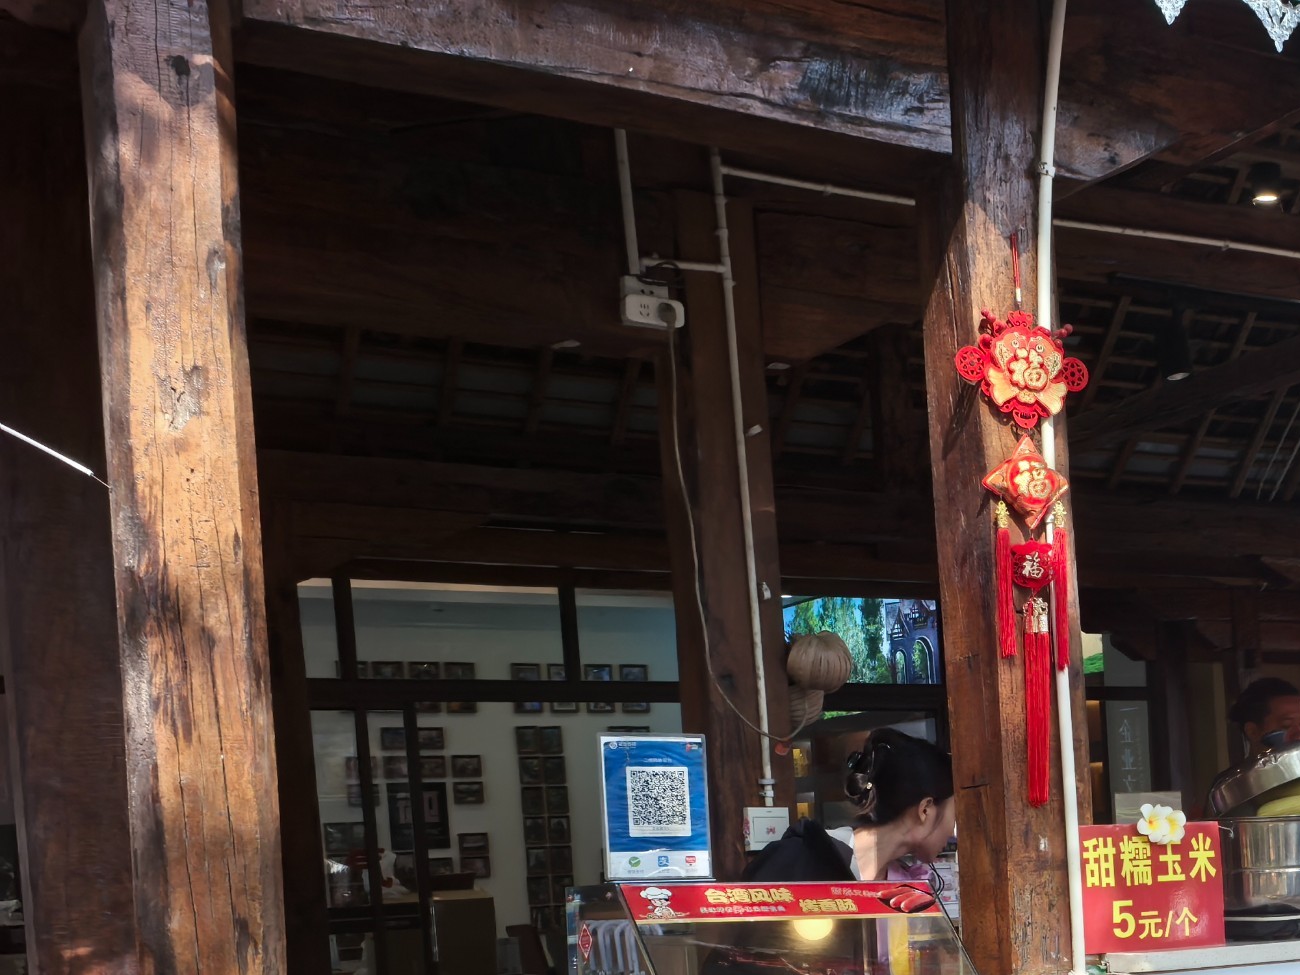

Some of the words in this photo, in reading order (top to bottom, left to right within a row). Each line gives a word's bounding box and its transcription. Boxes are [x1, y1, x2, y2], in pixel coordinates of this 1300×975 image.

[1009, 347, 1050, 391] 福
[1022, 552, 1045, 580] 福
[1083, 832, 1217, 888] 甜糯玉米
[704, 887, 795, 905] 台湾风味
[799, 898, 858, 914] 烤香肠
[1112, 900, 1198, 940] 5元/个
